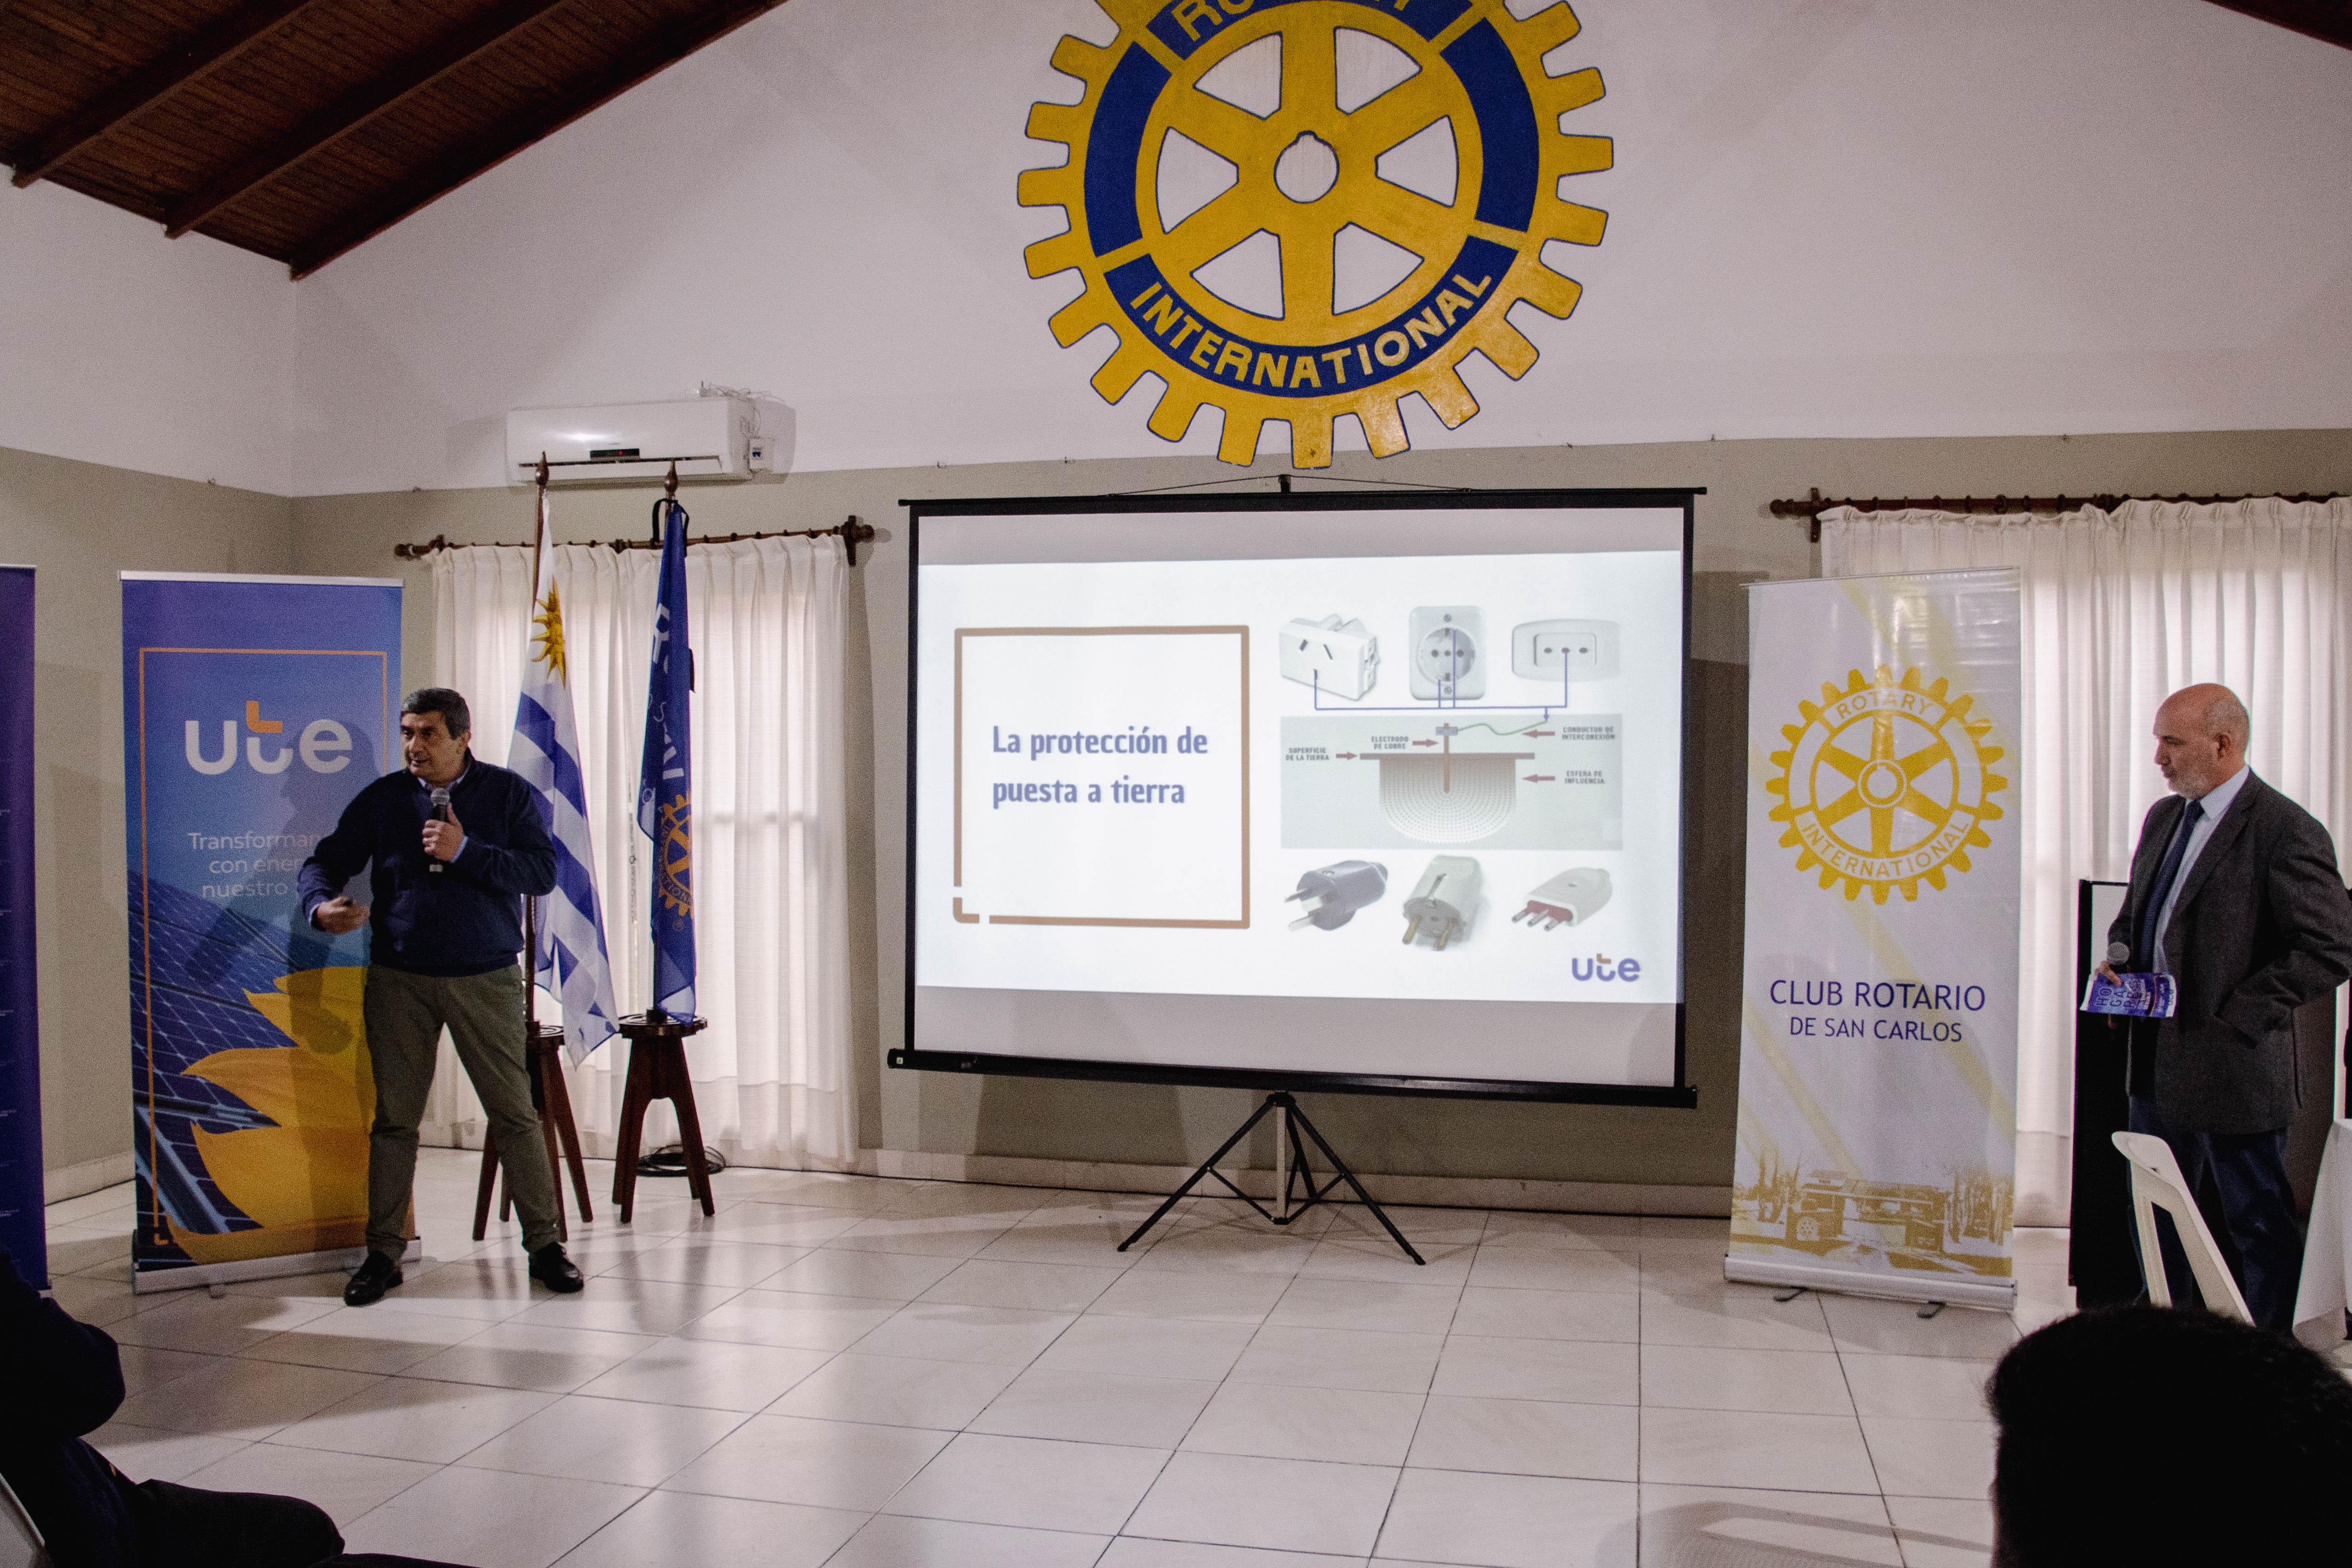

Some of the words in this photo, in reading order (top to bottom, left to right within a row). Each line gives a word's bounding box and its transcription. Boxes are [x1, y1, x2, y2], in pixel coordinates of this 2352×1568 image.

[1130, 274, 1492, 389] INTERNATIONAL
[1836, 691, 1935, 719] ROTARY
[185, 700, 352, 775] ute
[993, 725, 1021, 753] La
[1031, 725, 1167, 761] protección
[1177, 726, 1208, 754] de
[993, 780, 1077, 810] puesta
[1087, 784, 1101, 803] a
[1111, 775, 1185, 804] tierra
[1802, 822, 1969, 877] INTERNATIONAL
[209, 859, 248, 874] con
[201, 881, 288, 898] nuestro
[1572, 953, 1641, 982] ute
[1770, 980, 1843, 1006] CLUB
[1855, 982, 1985, 1011] ROTARIO
[1790, 1017, 1817, 1036] DE
[1824, 1018, 1864, 1038] SAN
[1874, 1020, 1962, 1042] CARLOS
